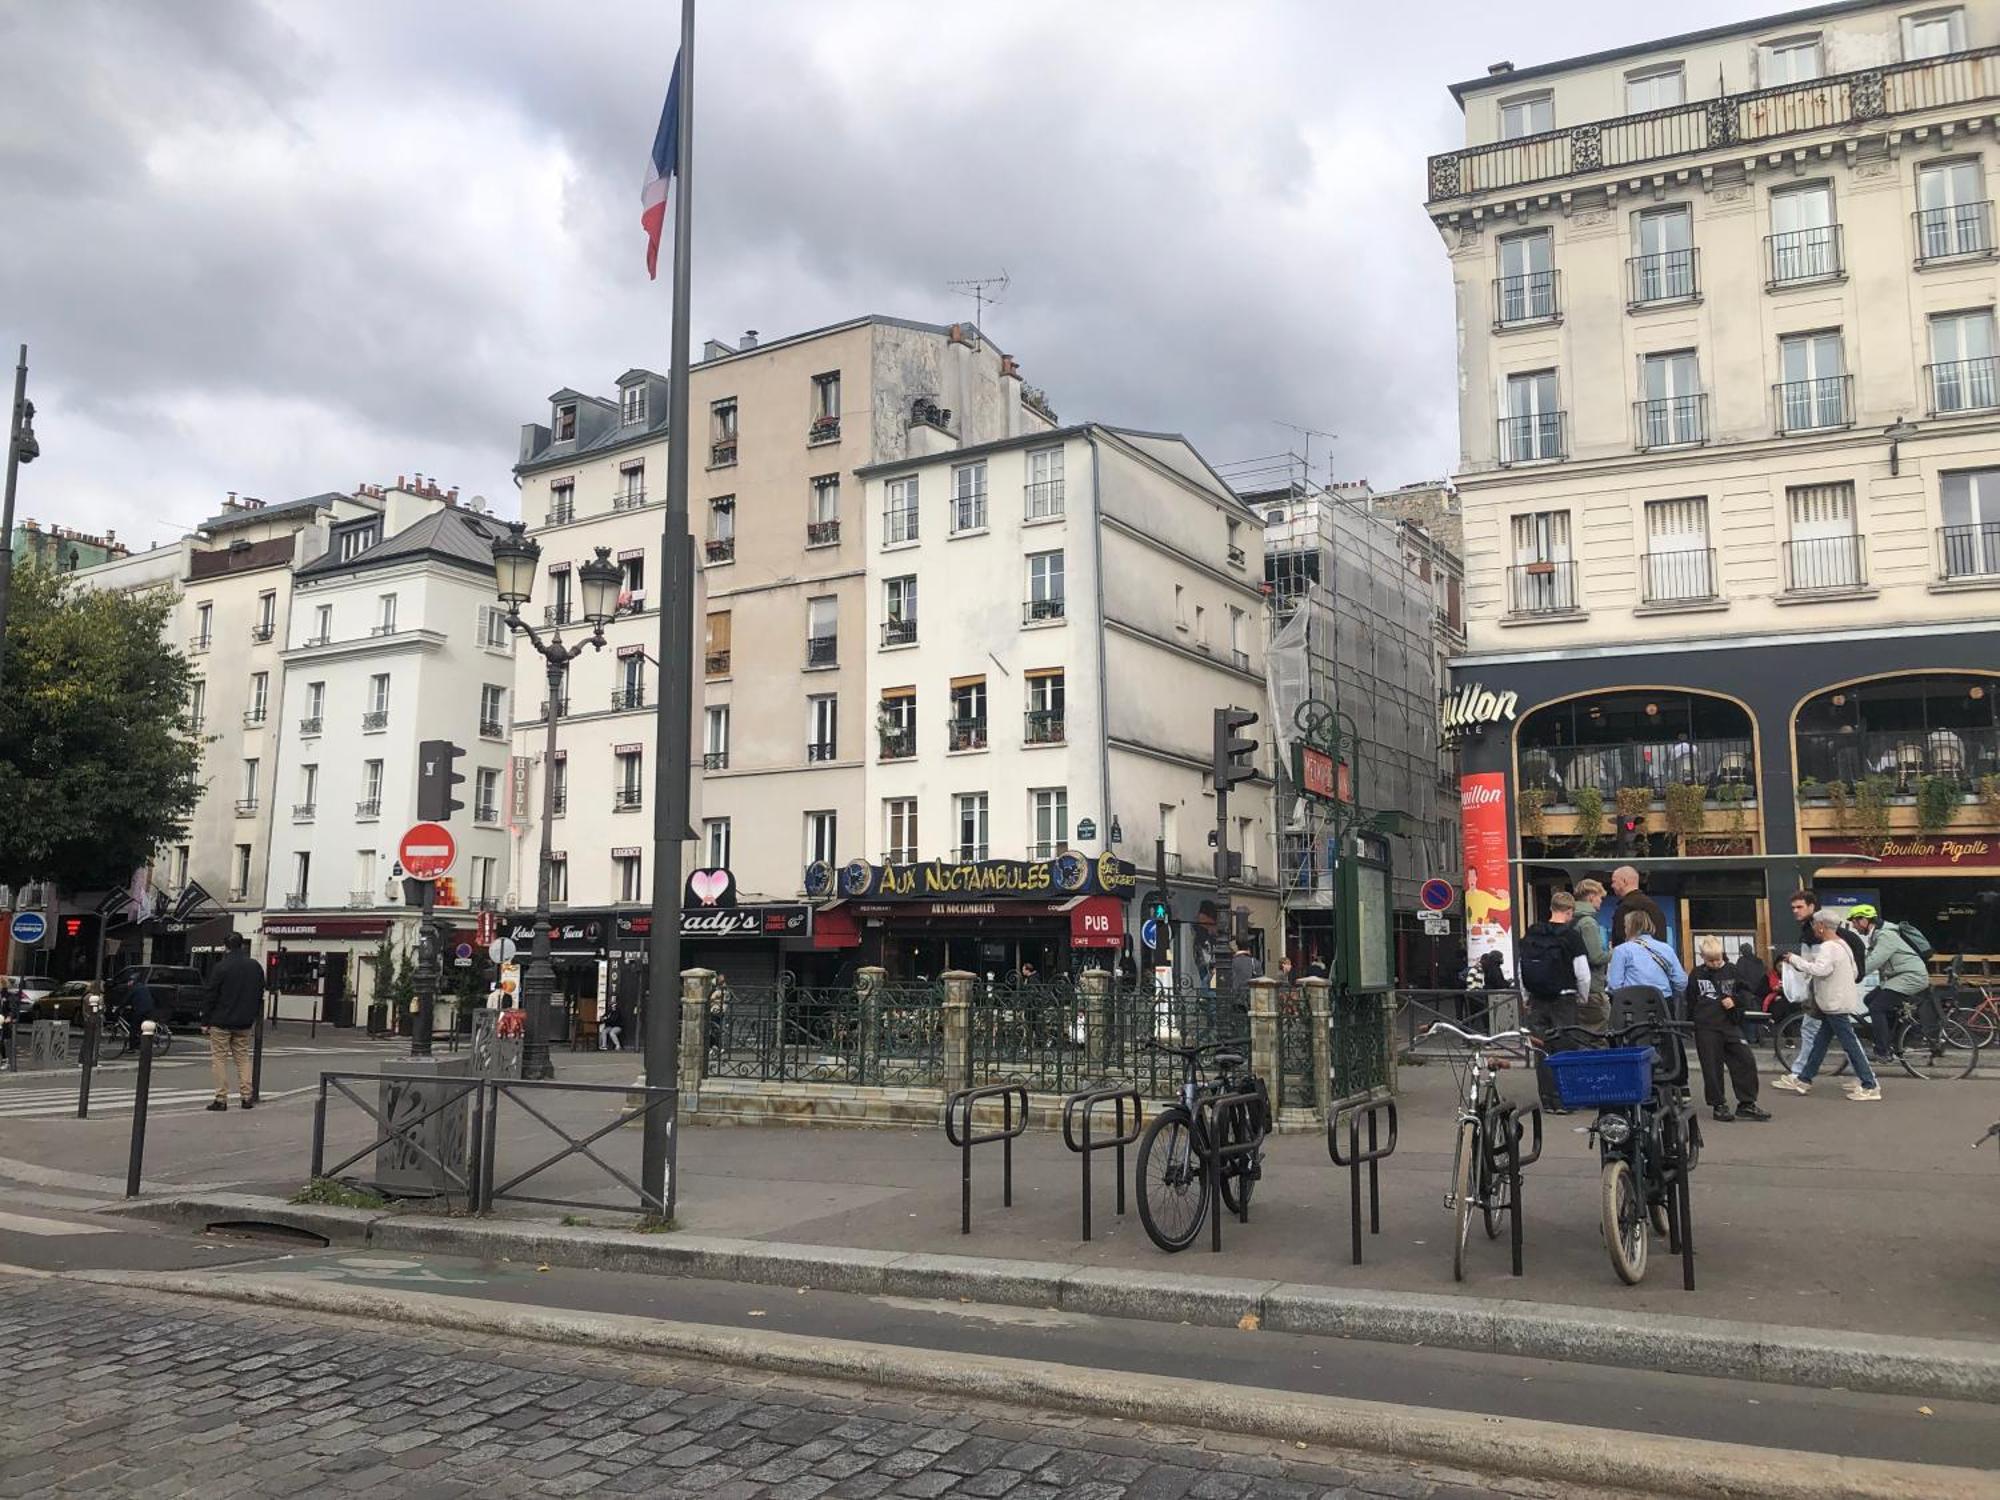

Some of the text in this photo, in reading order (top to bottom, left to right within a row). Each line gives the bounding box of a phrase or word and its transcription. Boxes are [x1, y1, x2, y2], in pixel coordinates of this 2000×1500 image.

[515, 758, 525, 815] HOTEL
[1881, 841, 1989, 863] Bouillon Pigalle
[264, 926, 317, 934] PIGALLERIE
[680, 911, 760, 936] ady's
[1085, 915, 1109, 931] PUB
